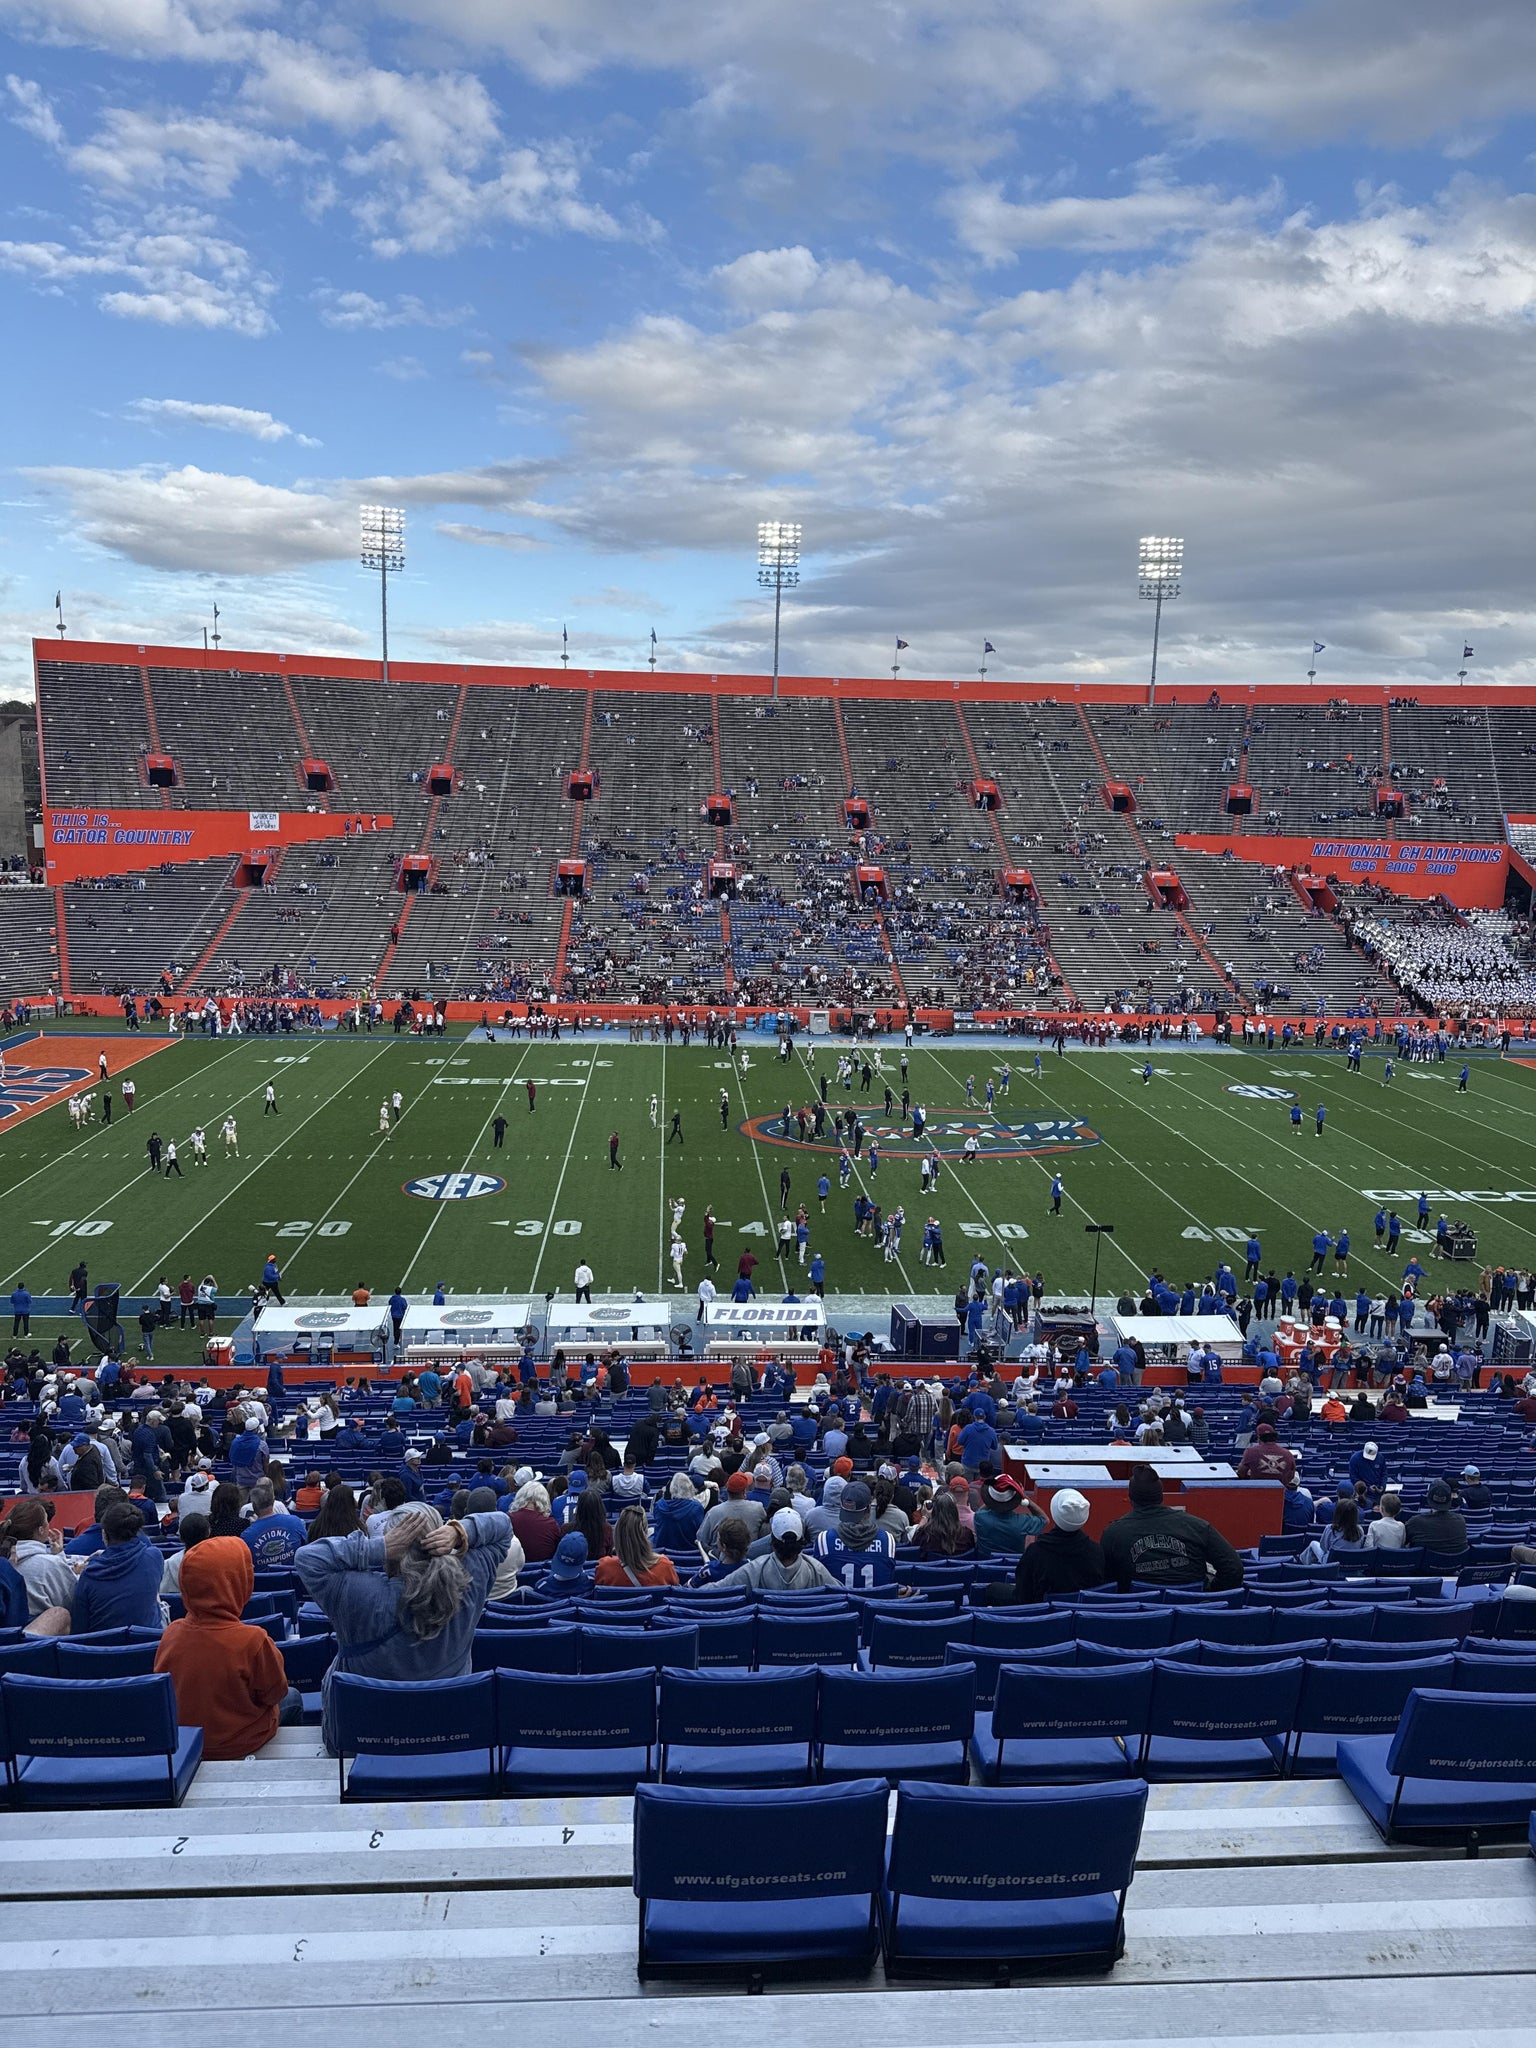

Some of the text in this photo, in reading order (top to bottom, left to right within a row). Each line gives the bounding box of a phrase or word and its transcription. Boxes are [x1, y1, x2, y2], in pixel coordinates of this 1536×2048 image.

[52, 813, 88, 827] THIS
[53, 828, 195, 845] GATOR COUNTRY
[1311, 842, 1503, 863] NATIONAL CHAMPIONS
[1350, 860, 1458, 875] 1996 2006 2008
[433, 1077, 587, 1086] GEICO
[1226, 1084, 1300, 1100] SEC
[411, 1173, 500, 1200] SEC
[48, 1220, 115, 1237] 10
[275, 1220, 353, 1237] 20
[513, 1220, 583, 1236] 30
[958, 1223, 1030, 1240] 50
[1181, 1226, 1251, 1243] 40
[713, 1308, 819, 1322] FLORIDA
[1208, 1359, 1218, 1371] 15
[90, 1409, 96, 1418] 2
[849, 1404, 856, 1415] 2
[1062, 1406, 1068, 1418] 1
[253, 1529, 292, 1549] NATIONAL
[256, 1550, 295, 1566] CHAMPIONS
[841, 1563, 874, 1588] 11
[1022, 1718, 1128, 1729] www.ufgatorseats.com
[1173, 1718, 1278, 1730] www.ufgatorseats.com
[1323, 1713, 1401, 1725] www.ufgatorseat
[519, 1726, 631, 1737] www.ufgatorseats.com
[684, 1724, 793, 1736] www.ufgatorseats.com
[843, 1724, 951, 1736] www.ufgatorseats.com
[28, 1735, 147, 1748] www.ufgatorseats.com
[357, 1732, 470, 1746] www.ufgatorseats.com
[1429, 1757, 1536, 1770] www.ufgatorseats.co
[368, 1829, 384, 1849] 3
[562, 1827, 576, 1844] 4
[171, 1836, 190, 1855] 2
[673, 1873, 848, 1890] www.ufgatorseats.com
[930, 1870, 1102, 1889] www.ufgatorseats.com
